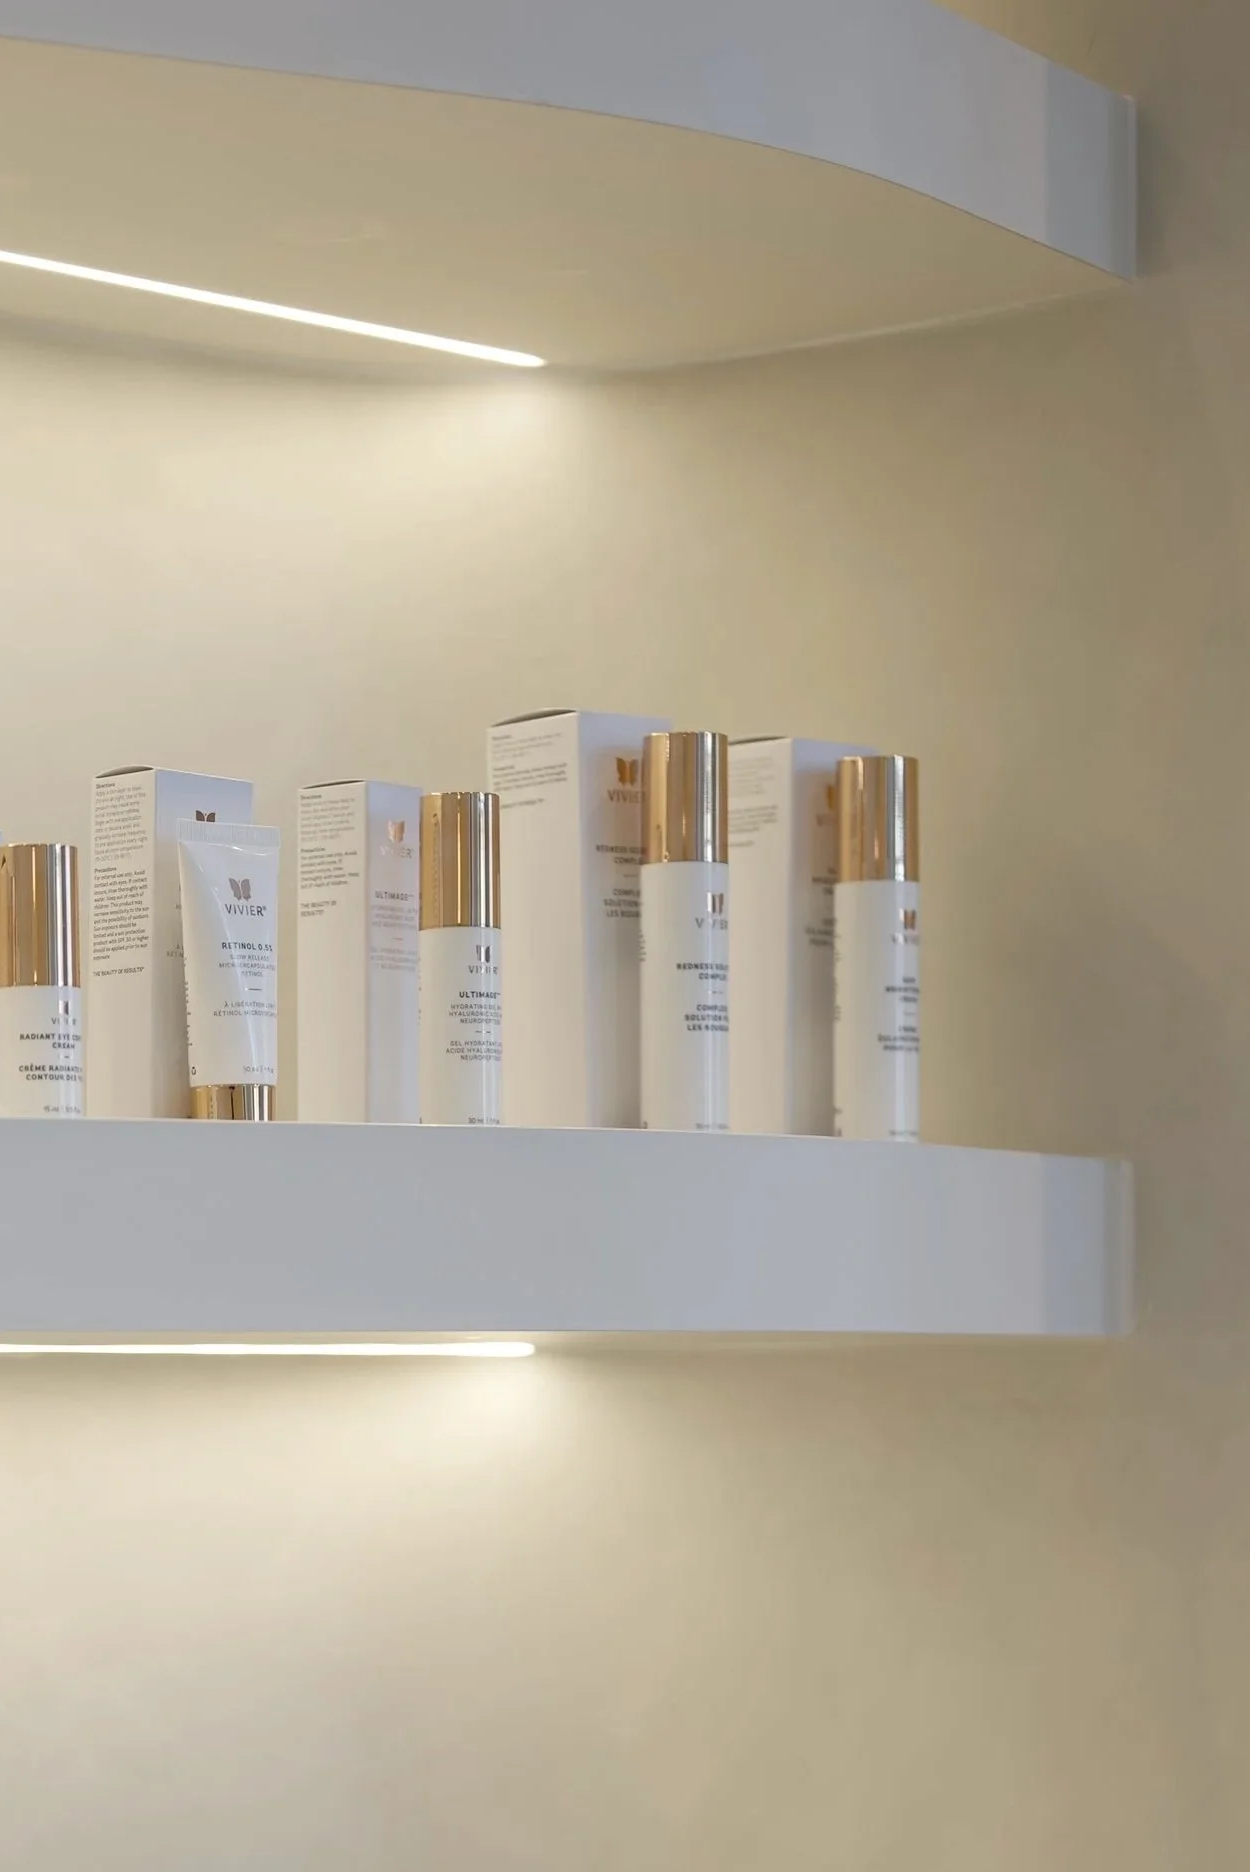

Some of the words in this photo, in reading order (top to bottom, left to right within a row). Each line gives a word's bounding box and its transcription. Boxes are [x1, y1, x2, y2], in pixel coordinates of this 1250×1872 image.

[221, 941, 256, 951] RETINOL
[19, 1032, 56, 1041] RADIANT
[51, 1041, 76, 1050] CREAM
[25, 1073, 65, 1081] CONTOUR
